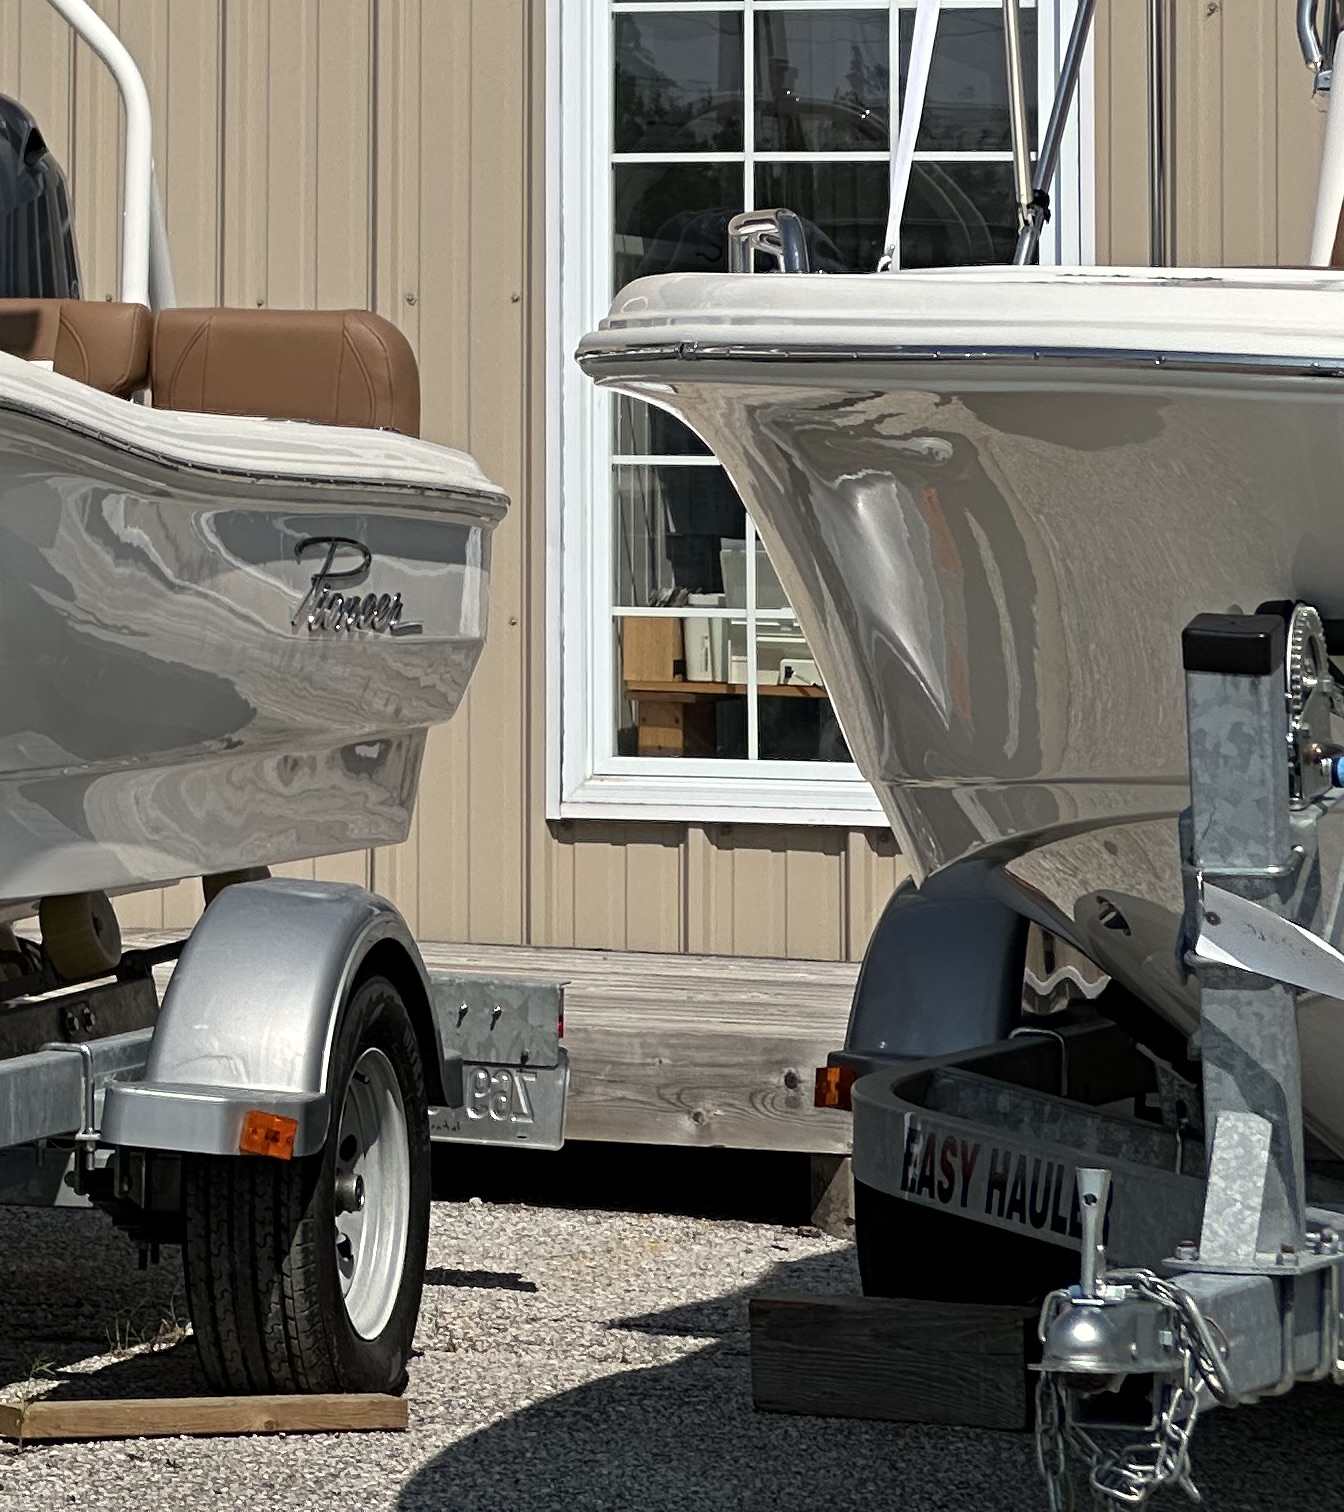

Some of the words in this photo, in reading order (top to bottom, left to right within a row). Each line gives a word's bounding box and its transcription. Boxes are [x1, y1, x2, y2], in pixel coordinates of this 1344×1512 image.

[291, 536, 406, 633] Pioneer
[900, 1125, 981, 1209] EASY
[985, 1147, 1113, 1248] HAUL
